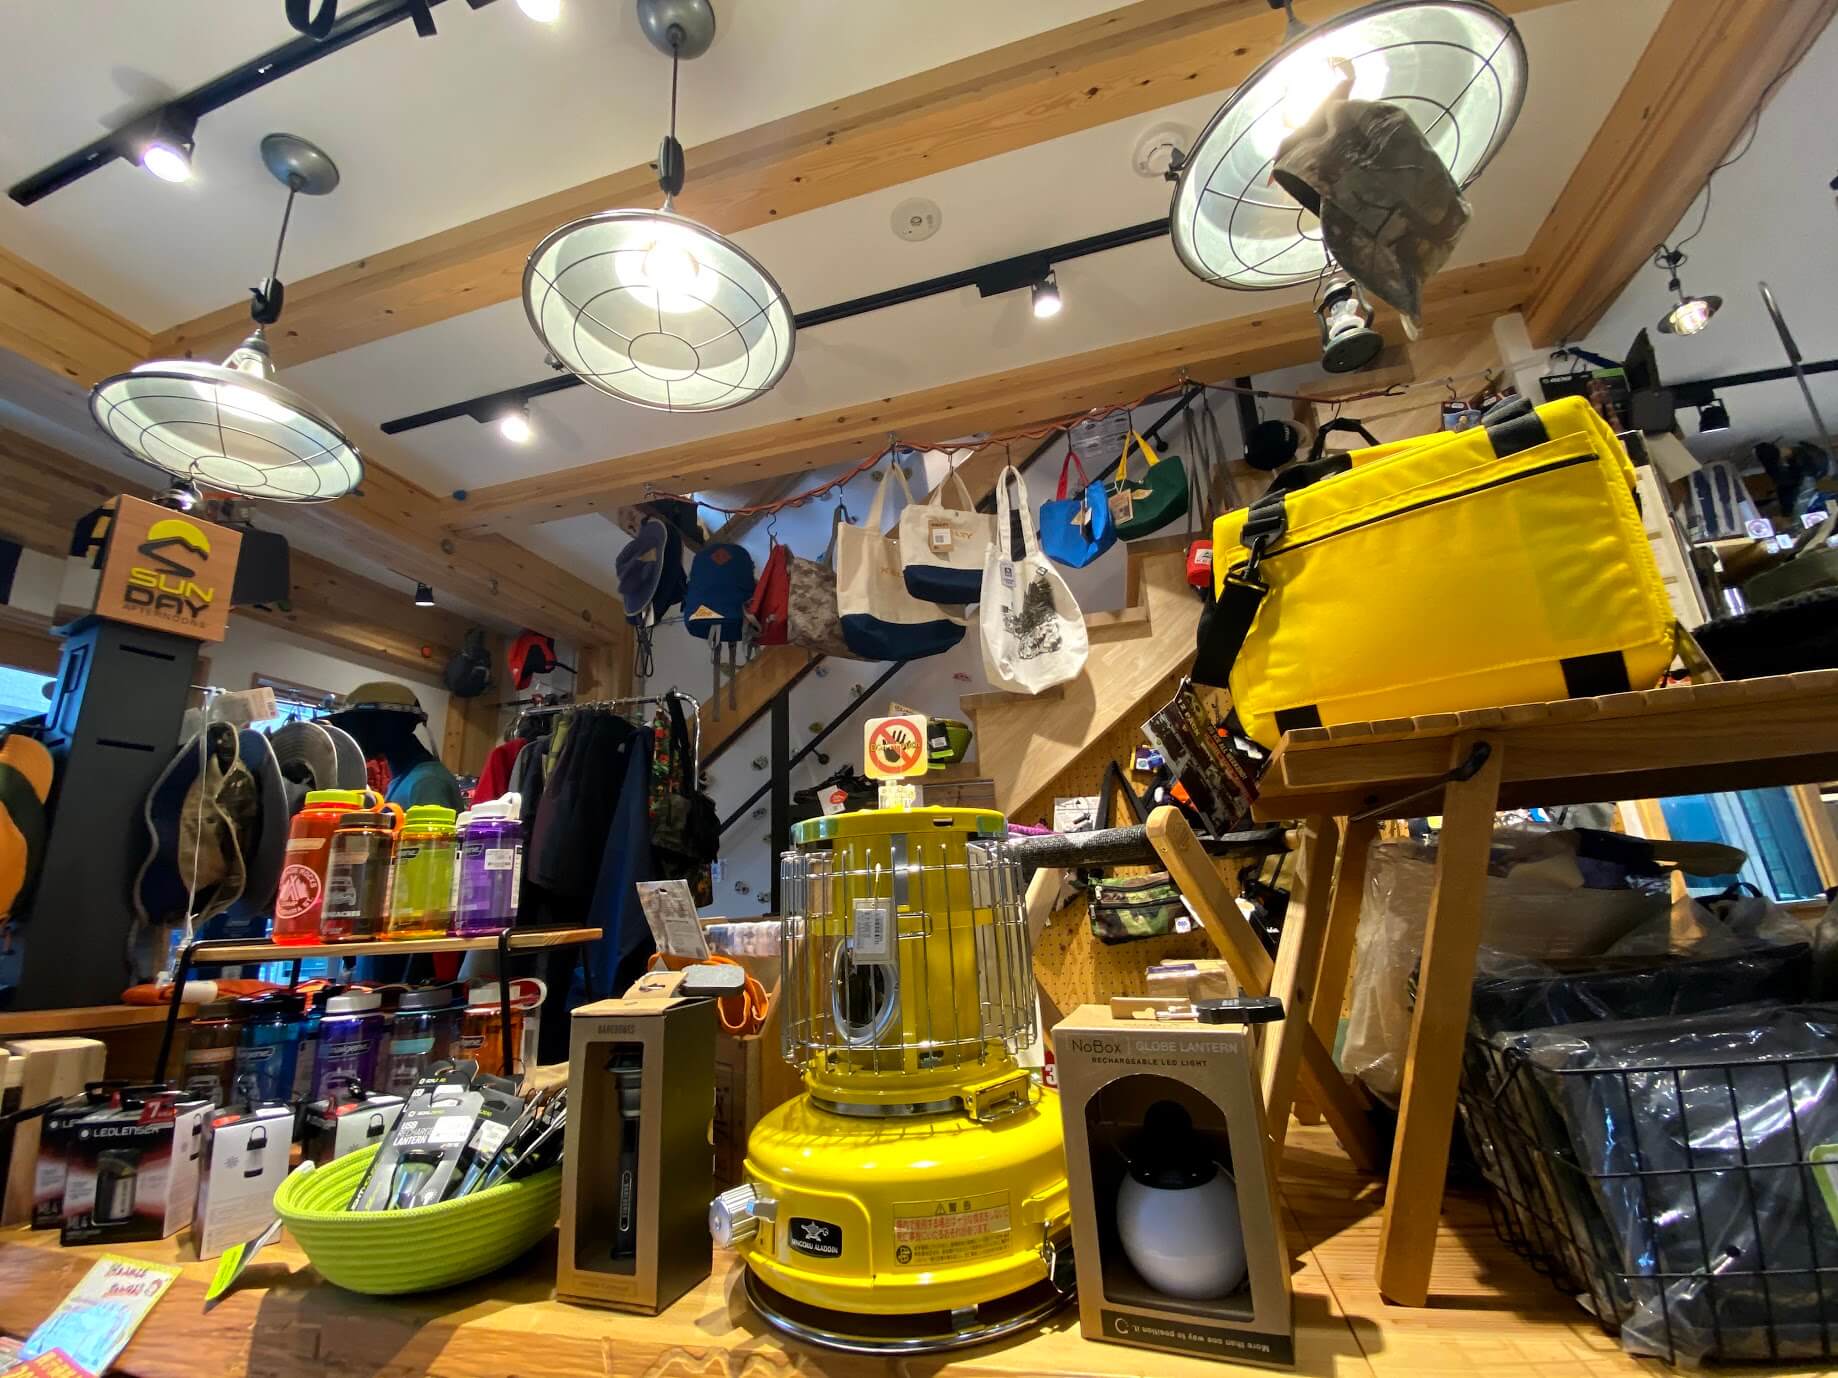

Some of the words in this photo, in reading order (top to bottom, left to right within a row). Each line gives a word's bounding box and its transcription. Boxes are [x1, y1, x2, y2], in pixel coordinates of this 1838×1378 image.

[128, 567, 215, 603] SUN
[125, 585, 209, 618] DAY
[1072, 1039, 1121, 1054] NoBox
[1135, 1041, 1177, 1054] GLOBE
[1180, 1042, 1239, 1055] LANTERN
[1091, 1056, 1157, 1066] RECHARGEABLE
[1161, 1058, 1178, 1066] LED
[401, 1120, 418, 1130] USB
[93, 1126, 160, 1138] LEDLENSER
[393, 1134, 428, 1146] LANTERN
[814, 1243, 839, 1254] ALADDIN
[1142, 1327, 1176, 1338] position
[1177, 1331, 1187, 1340] to
[1188, 1332, 1206, 1342] way
[1207, 1336, 1223, 1345] one
[1225, 1338, 1245, 1348] than
[1248, 1341, 1270, 1352] More
